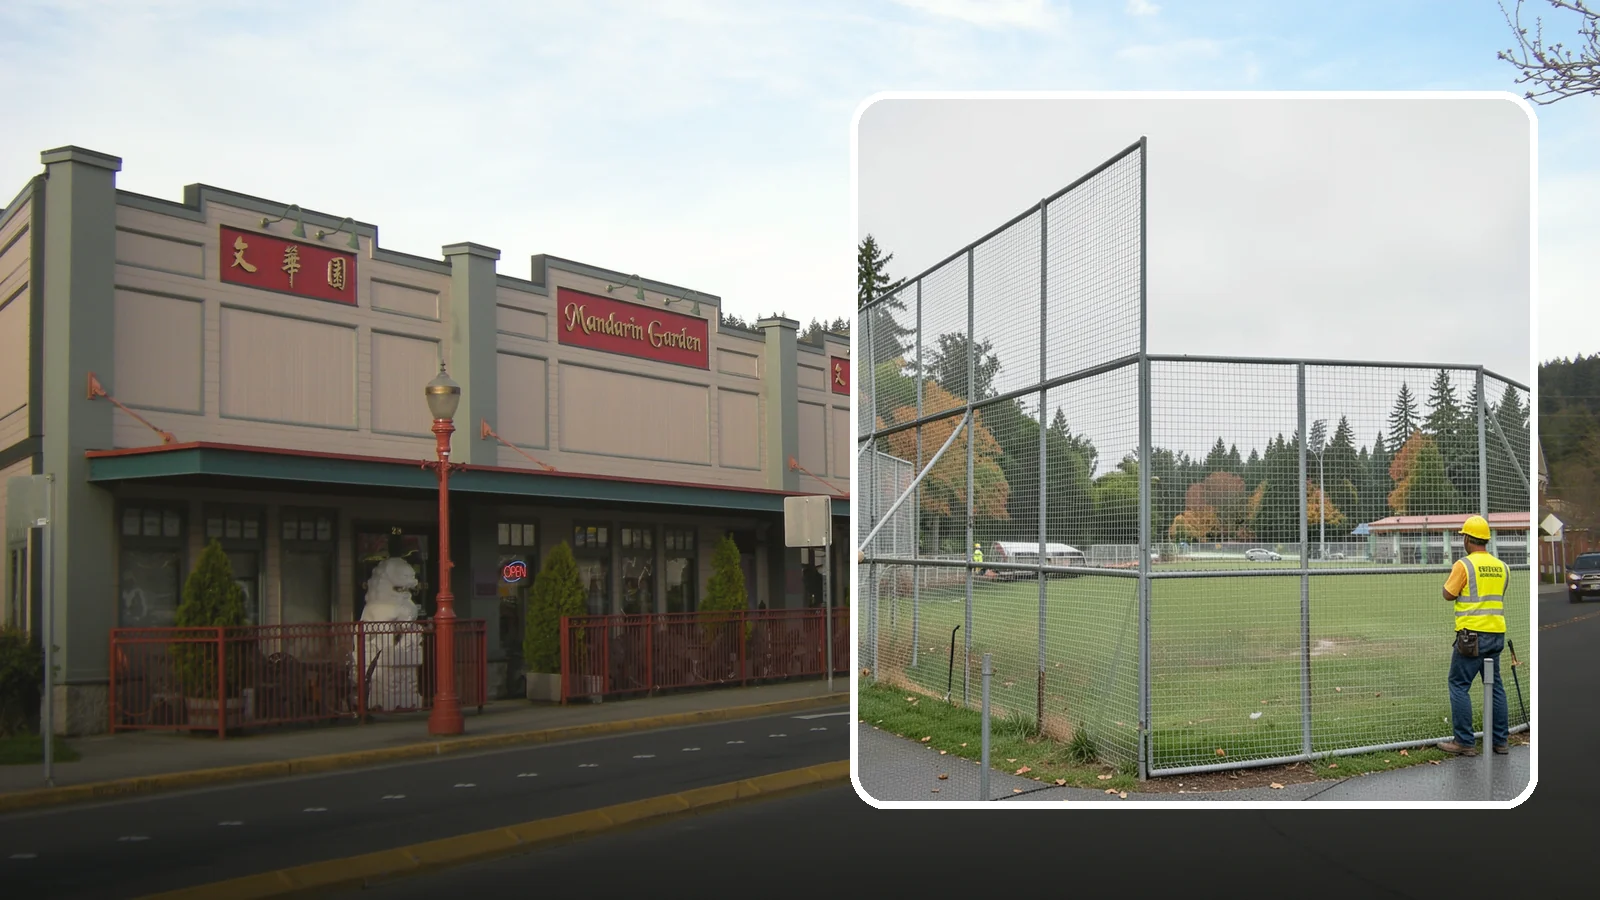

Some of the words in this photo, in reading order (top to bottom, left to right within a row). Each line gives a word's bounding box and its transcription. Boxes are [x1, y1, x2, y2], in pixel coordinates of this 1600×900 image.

[230, 235, 347, 291] 文華園
[564, 302, 644, 341] Mandarin
[647, 320, 702, 352] Garden
[503, 565, 527, 578] OPEN
